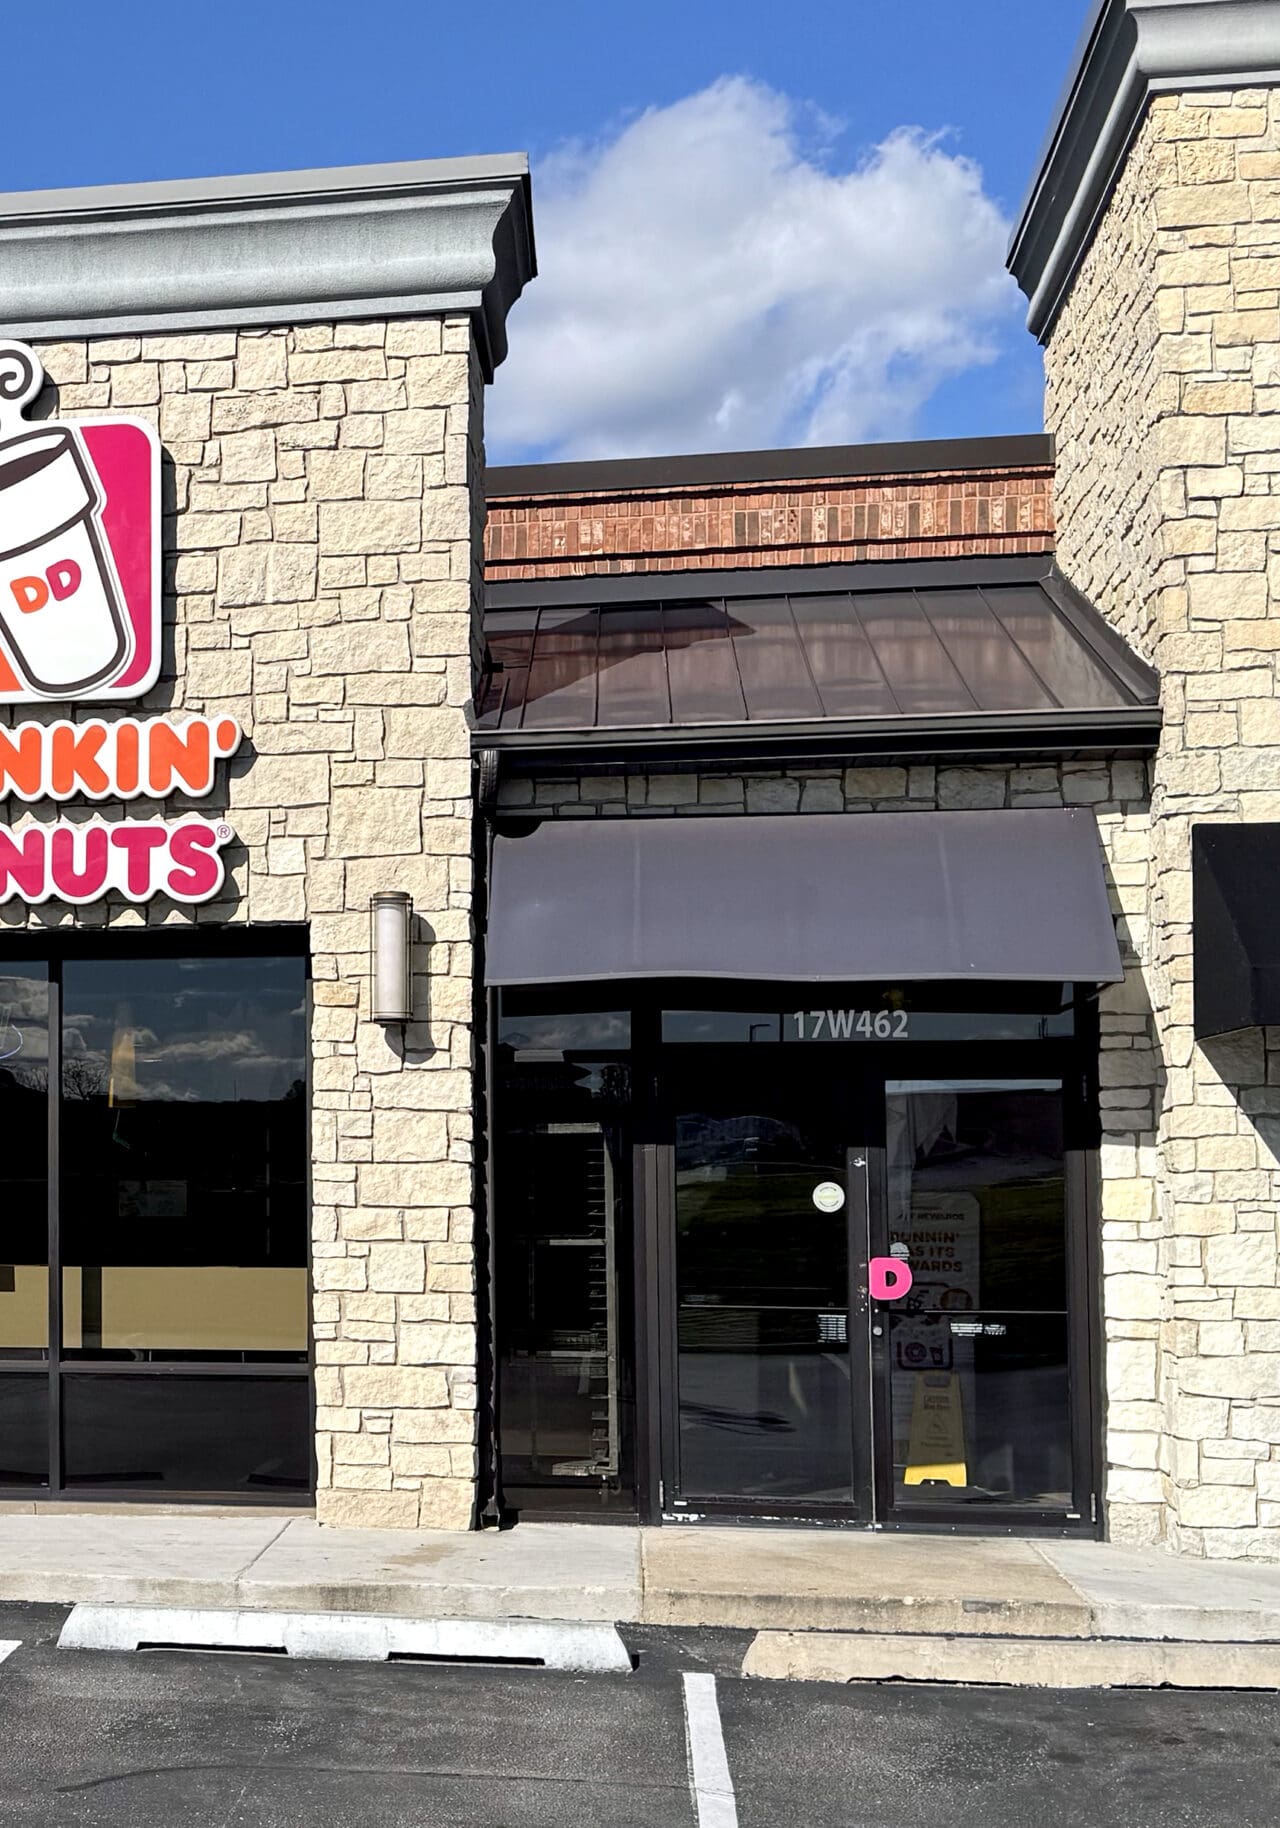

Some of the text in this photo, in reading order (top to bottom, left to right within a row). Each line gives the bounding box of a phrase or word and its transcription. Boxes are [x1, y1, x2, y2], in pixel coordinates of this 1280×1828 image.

[10, 558, 82, 614] DD
[793, 1009, 910, 1040] 17W462
[869, 1256, 914, 1301] D
